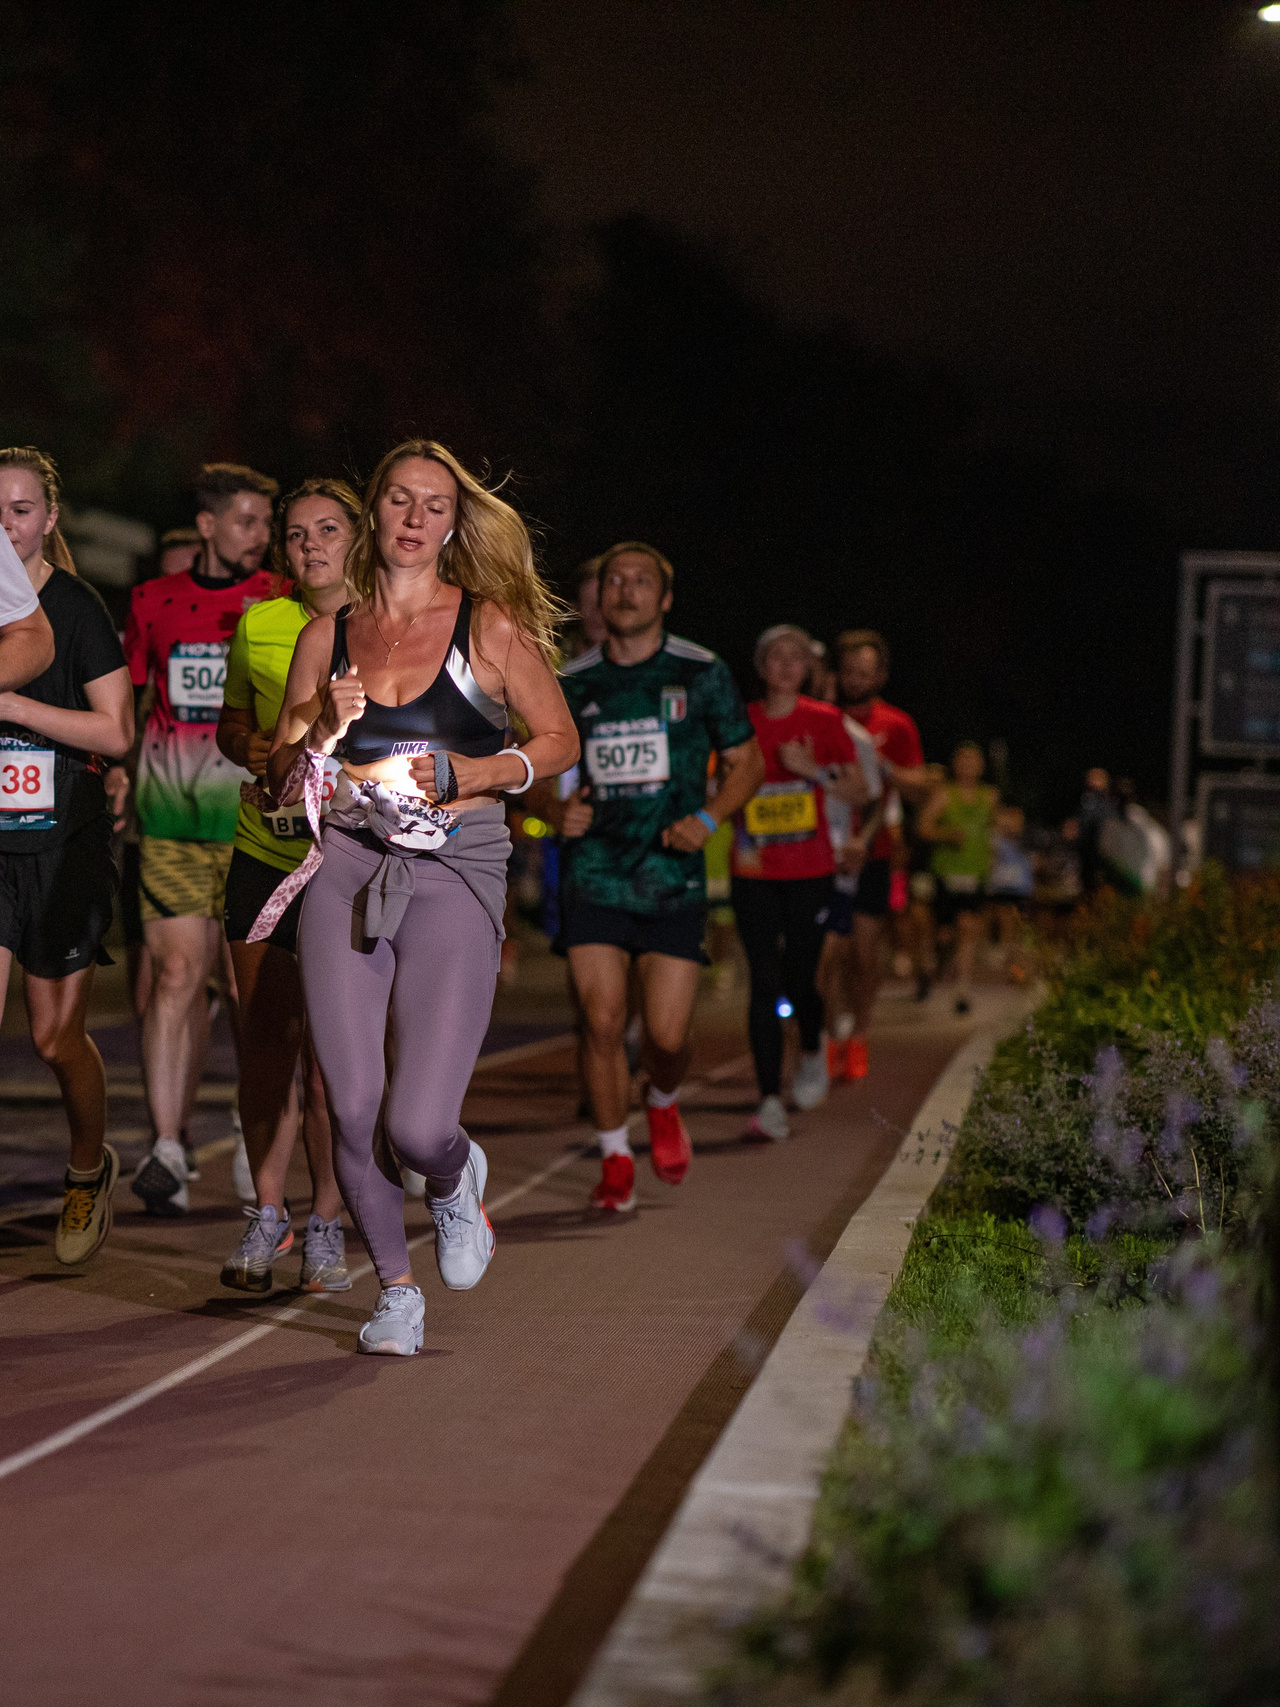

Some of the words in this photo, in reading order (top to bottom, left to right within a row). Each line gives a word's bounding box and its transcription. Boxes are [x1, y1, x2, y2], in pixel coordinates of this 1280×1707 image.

[182, 665, 226, 690] 504
[391, 741, 429, 757] NIKE
[596, 741, 658, 769] 5075
